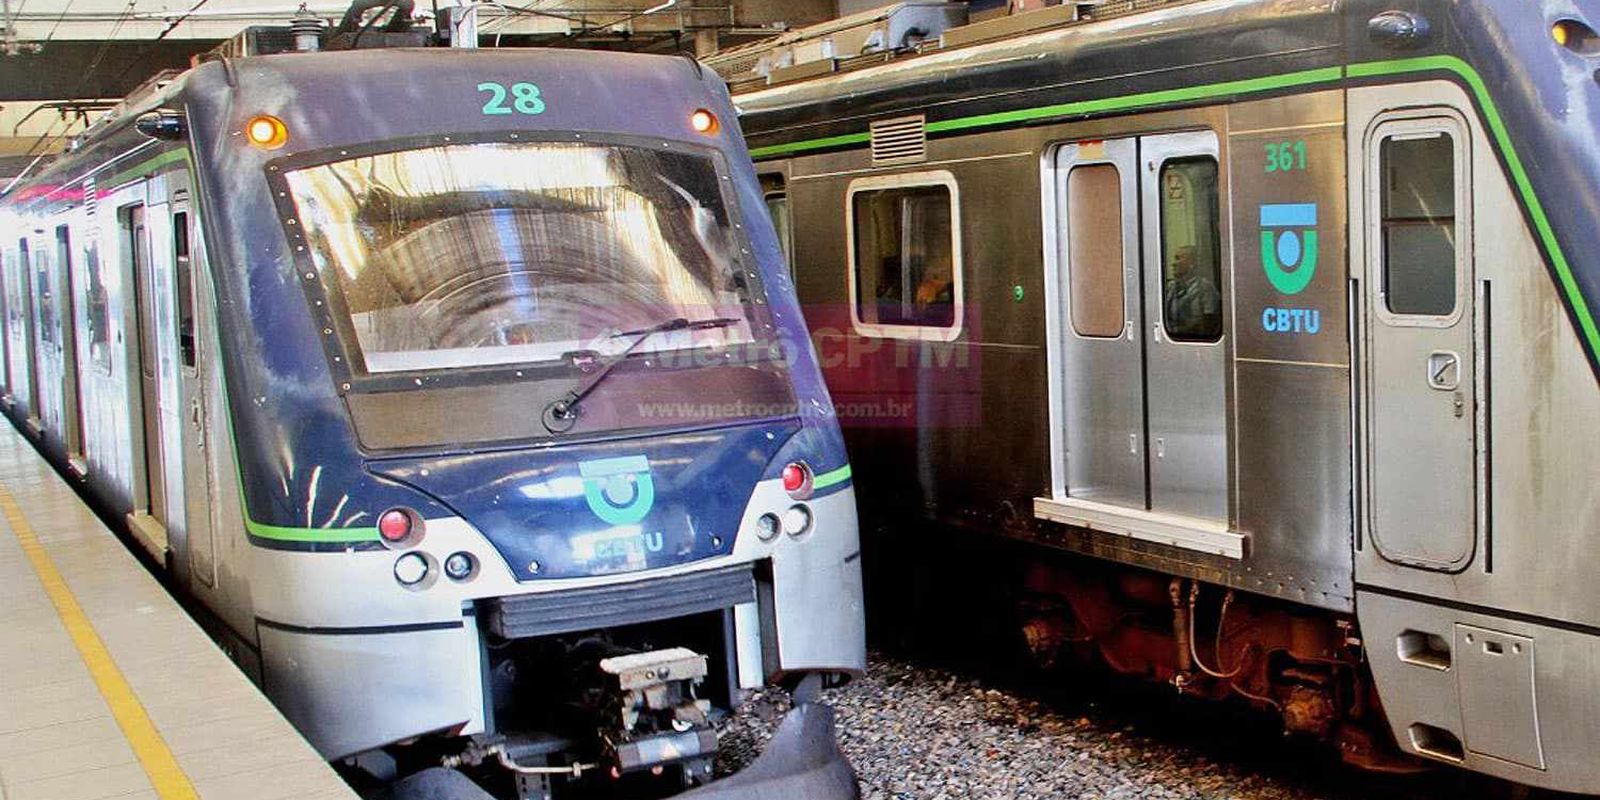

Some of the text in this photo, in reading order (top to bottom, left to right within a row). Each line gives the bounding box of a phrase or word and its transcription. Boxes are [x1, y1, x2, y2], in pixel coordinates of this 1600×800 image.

[477, 82, 546, 115] 28
[1264, 141, 1307, 173] 361
[1262, 307, 1320, 334] CBTU
